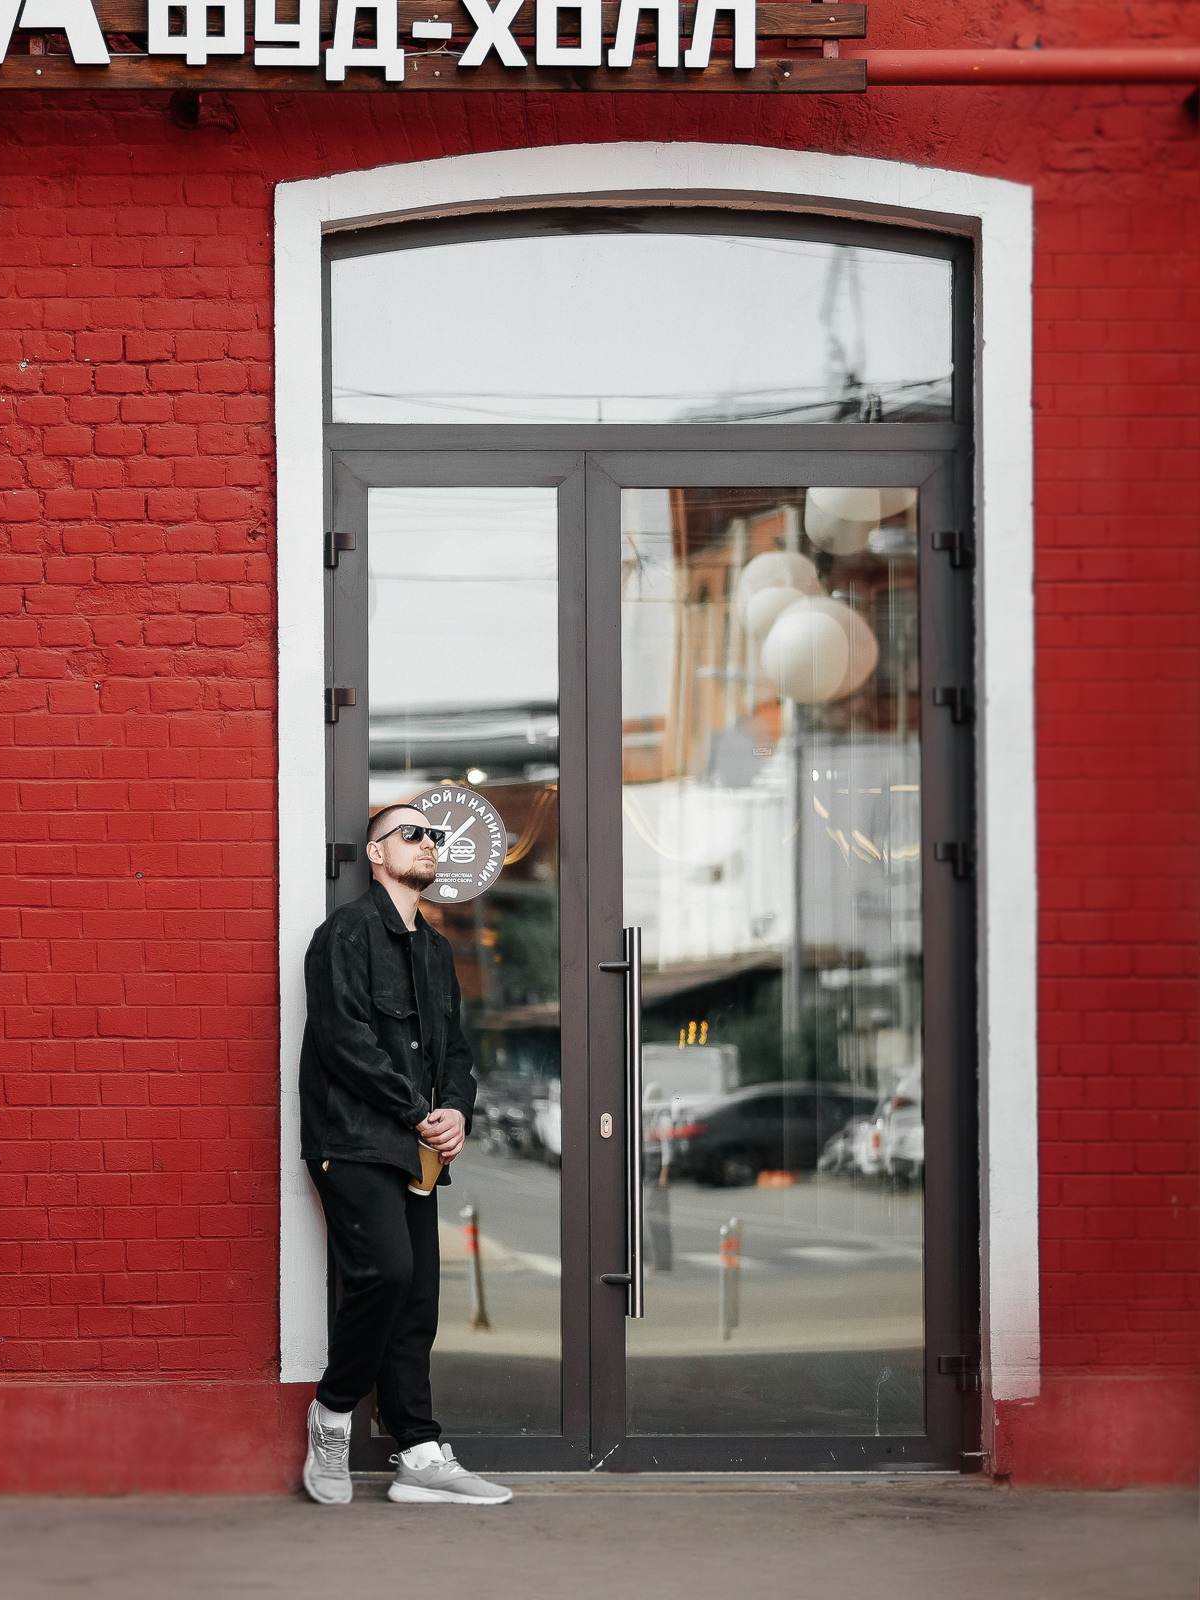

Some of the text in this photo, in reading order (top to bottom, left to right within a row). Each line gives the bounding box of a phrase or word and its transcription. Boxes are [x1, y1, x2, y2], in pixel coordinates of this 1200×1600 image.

[413, 789, 502, 882] ДОЙ И НАПИТКАМИ
